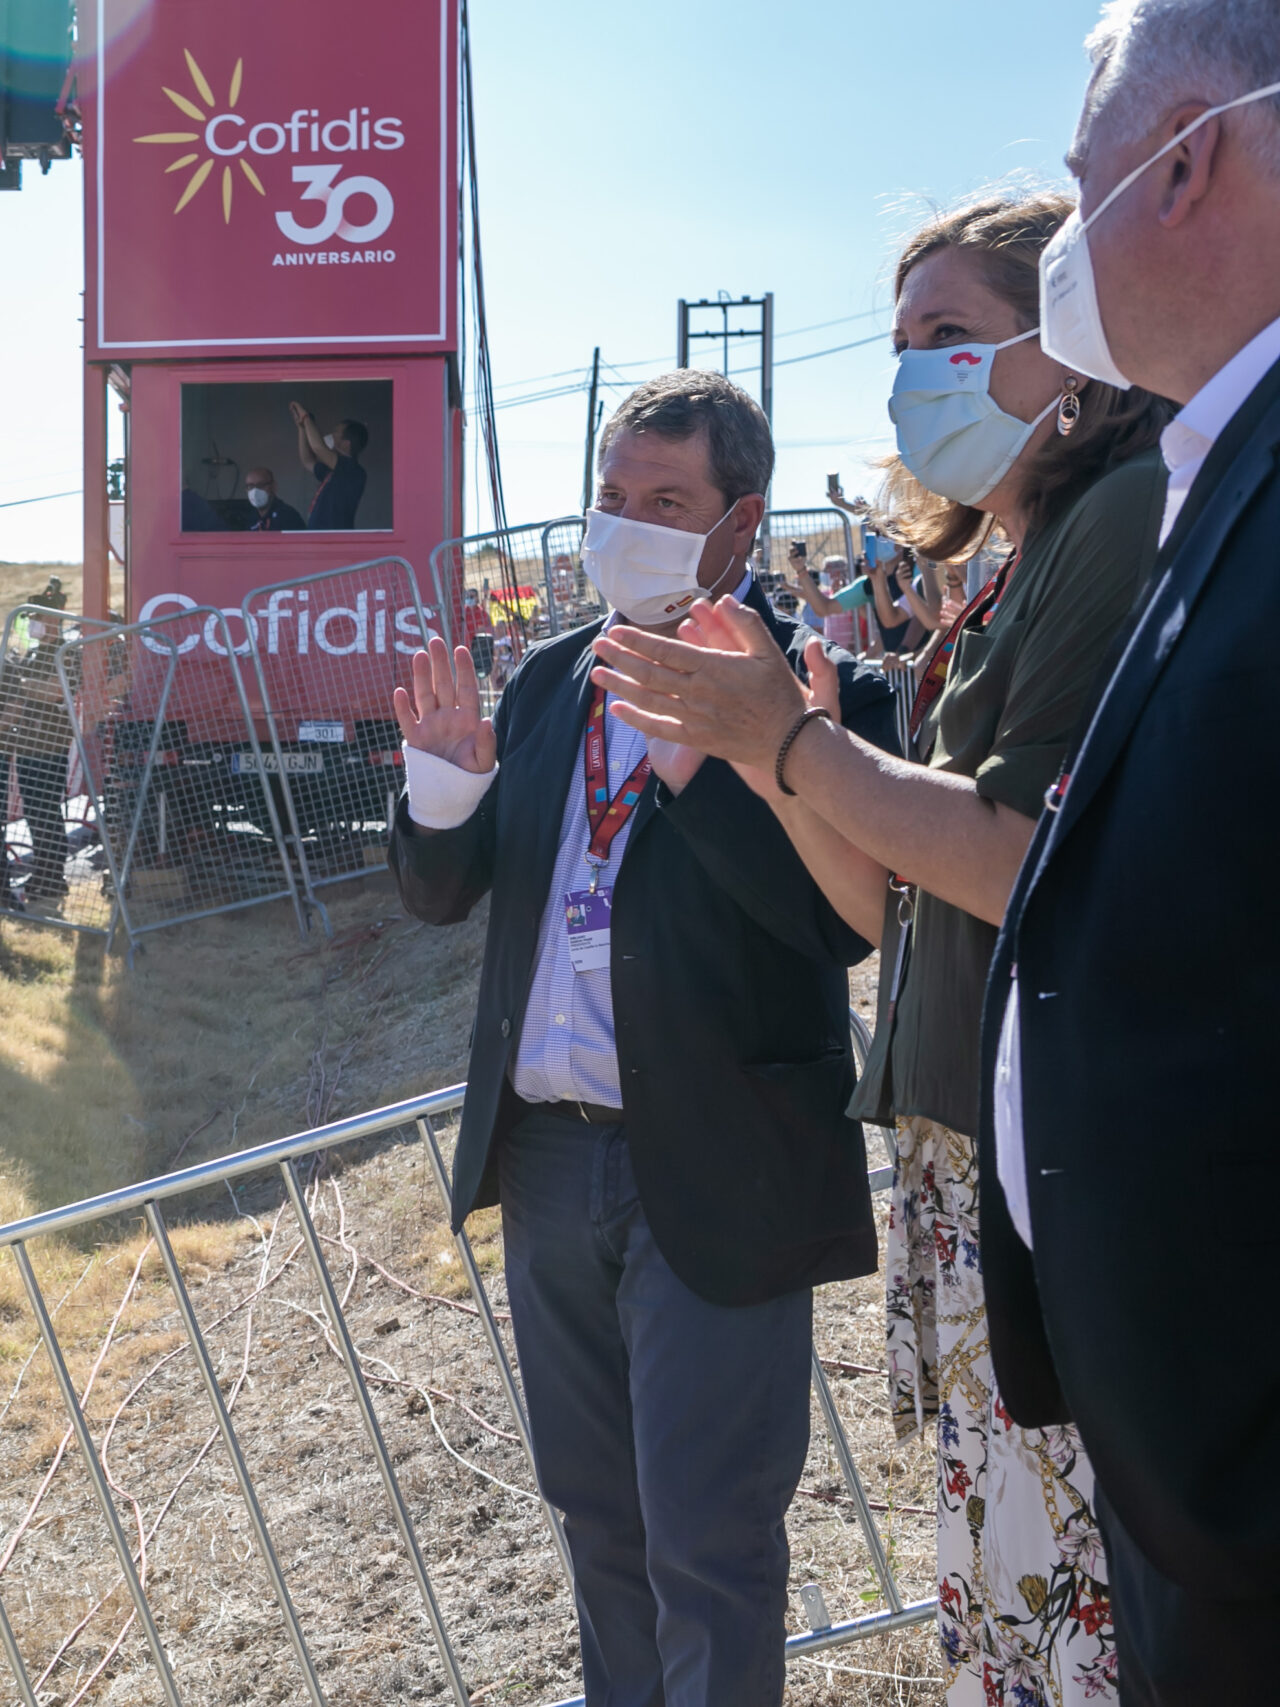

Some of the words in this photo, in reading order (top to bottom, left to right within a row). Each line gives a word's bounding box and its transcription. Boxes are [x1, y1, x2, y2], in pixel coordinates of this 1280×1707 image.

[205, 107, 405, 156] Cofidis
[274, 164, 395, 246] 30
[272, 250, 396, 267] ANIVERSARIO
[138, 589, 437, 656] Cofidis
